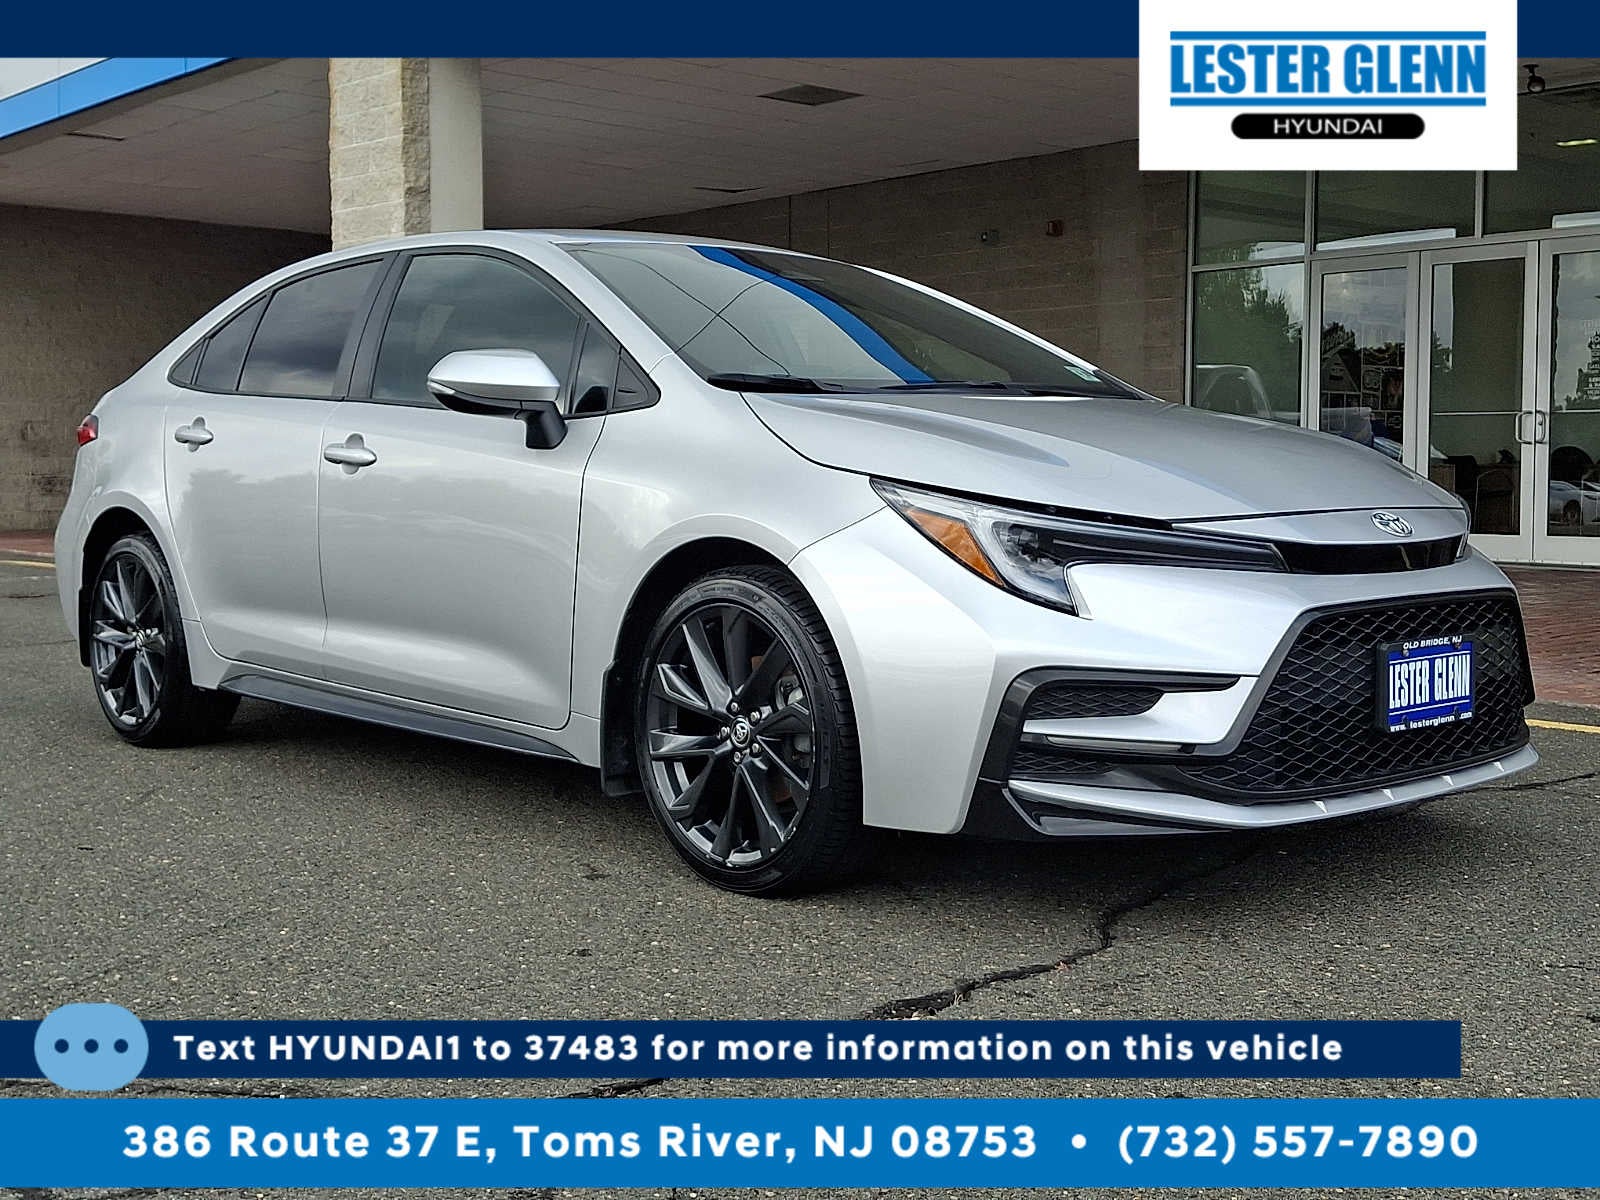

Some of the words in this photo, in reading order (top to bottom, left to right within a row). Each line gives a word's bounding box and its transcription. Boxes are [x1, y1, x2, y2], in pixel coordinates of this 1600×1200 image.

[1403, 641, 1419, 650] OLD
[1452, 635, 1462, 643] NJ
[1389, 660, 1430, 709] LESTER
[1434, 654, 1471, 701] GLENN
